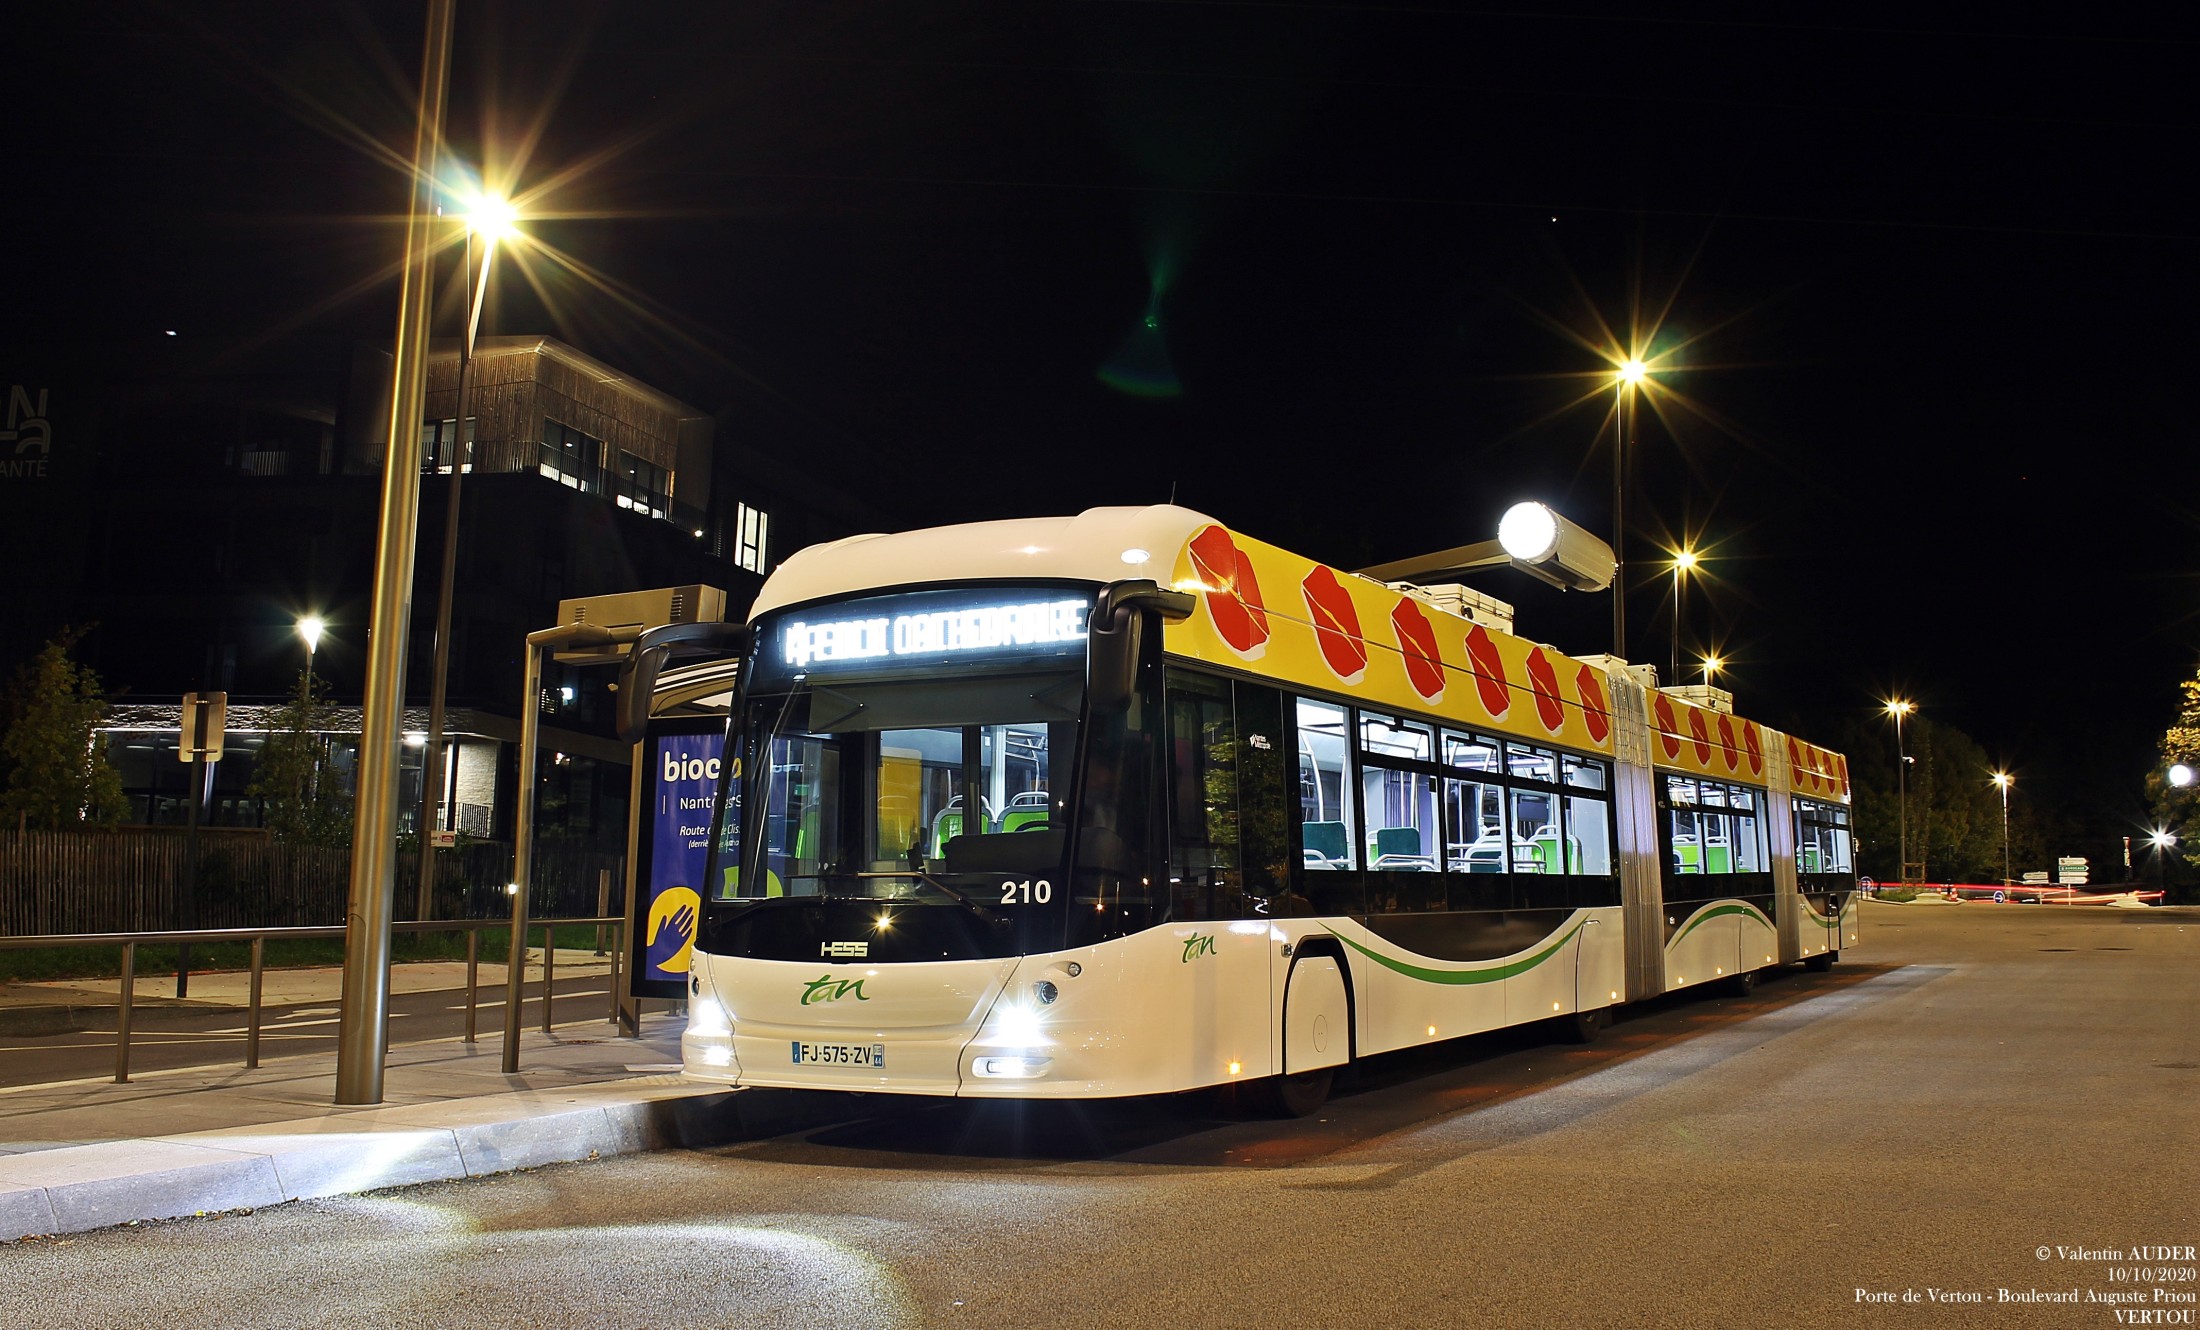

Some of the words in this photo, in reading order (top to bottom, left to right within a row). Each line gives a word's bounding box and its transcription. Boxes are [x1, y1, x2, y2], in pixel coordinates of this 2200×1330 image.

[679, 825, 705, 836] Route
[1000, 879, 1052, 905] 210
[820, 941, 869, 957] HESS
[1182, 931, 1218, 964] tan
[800, 974, 871, 1006] tan
